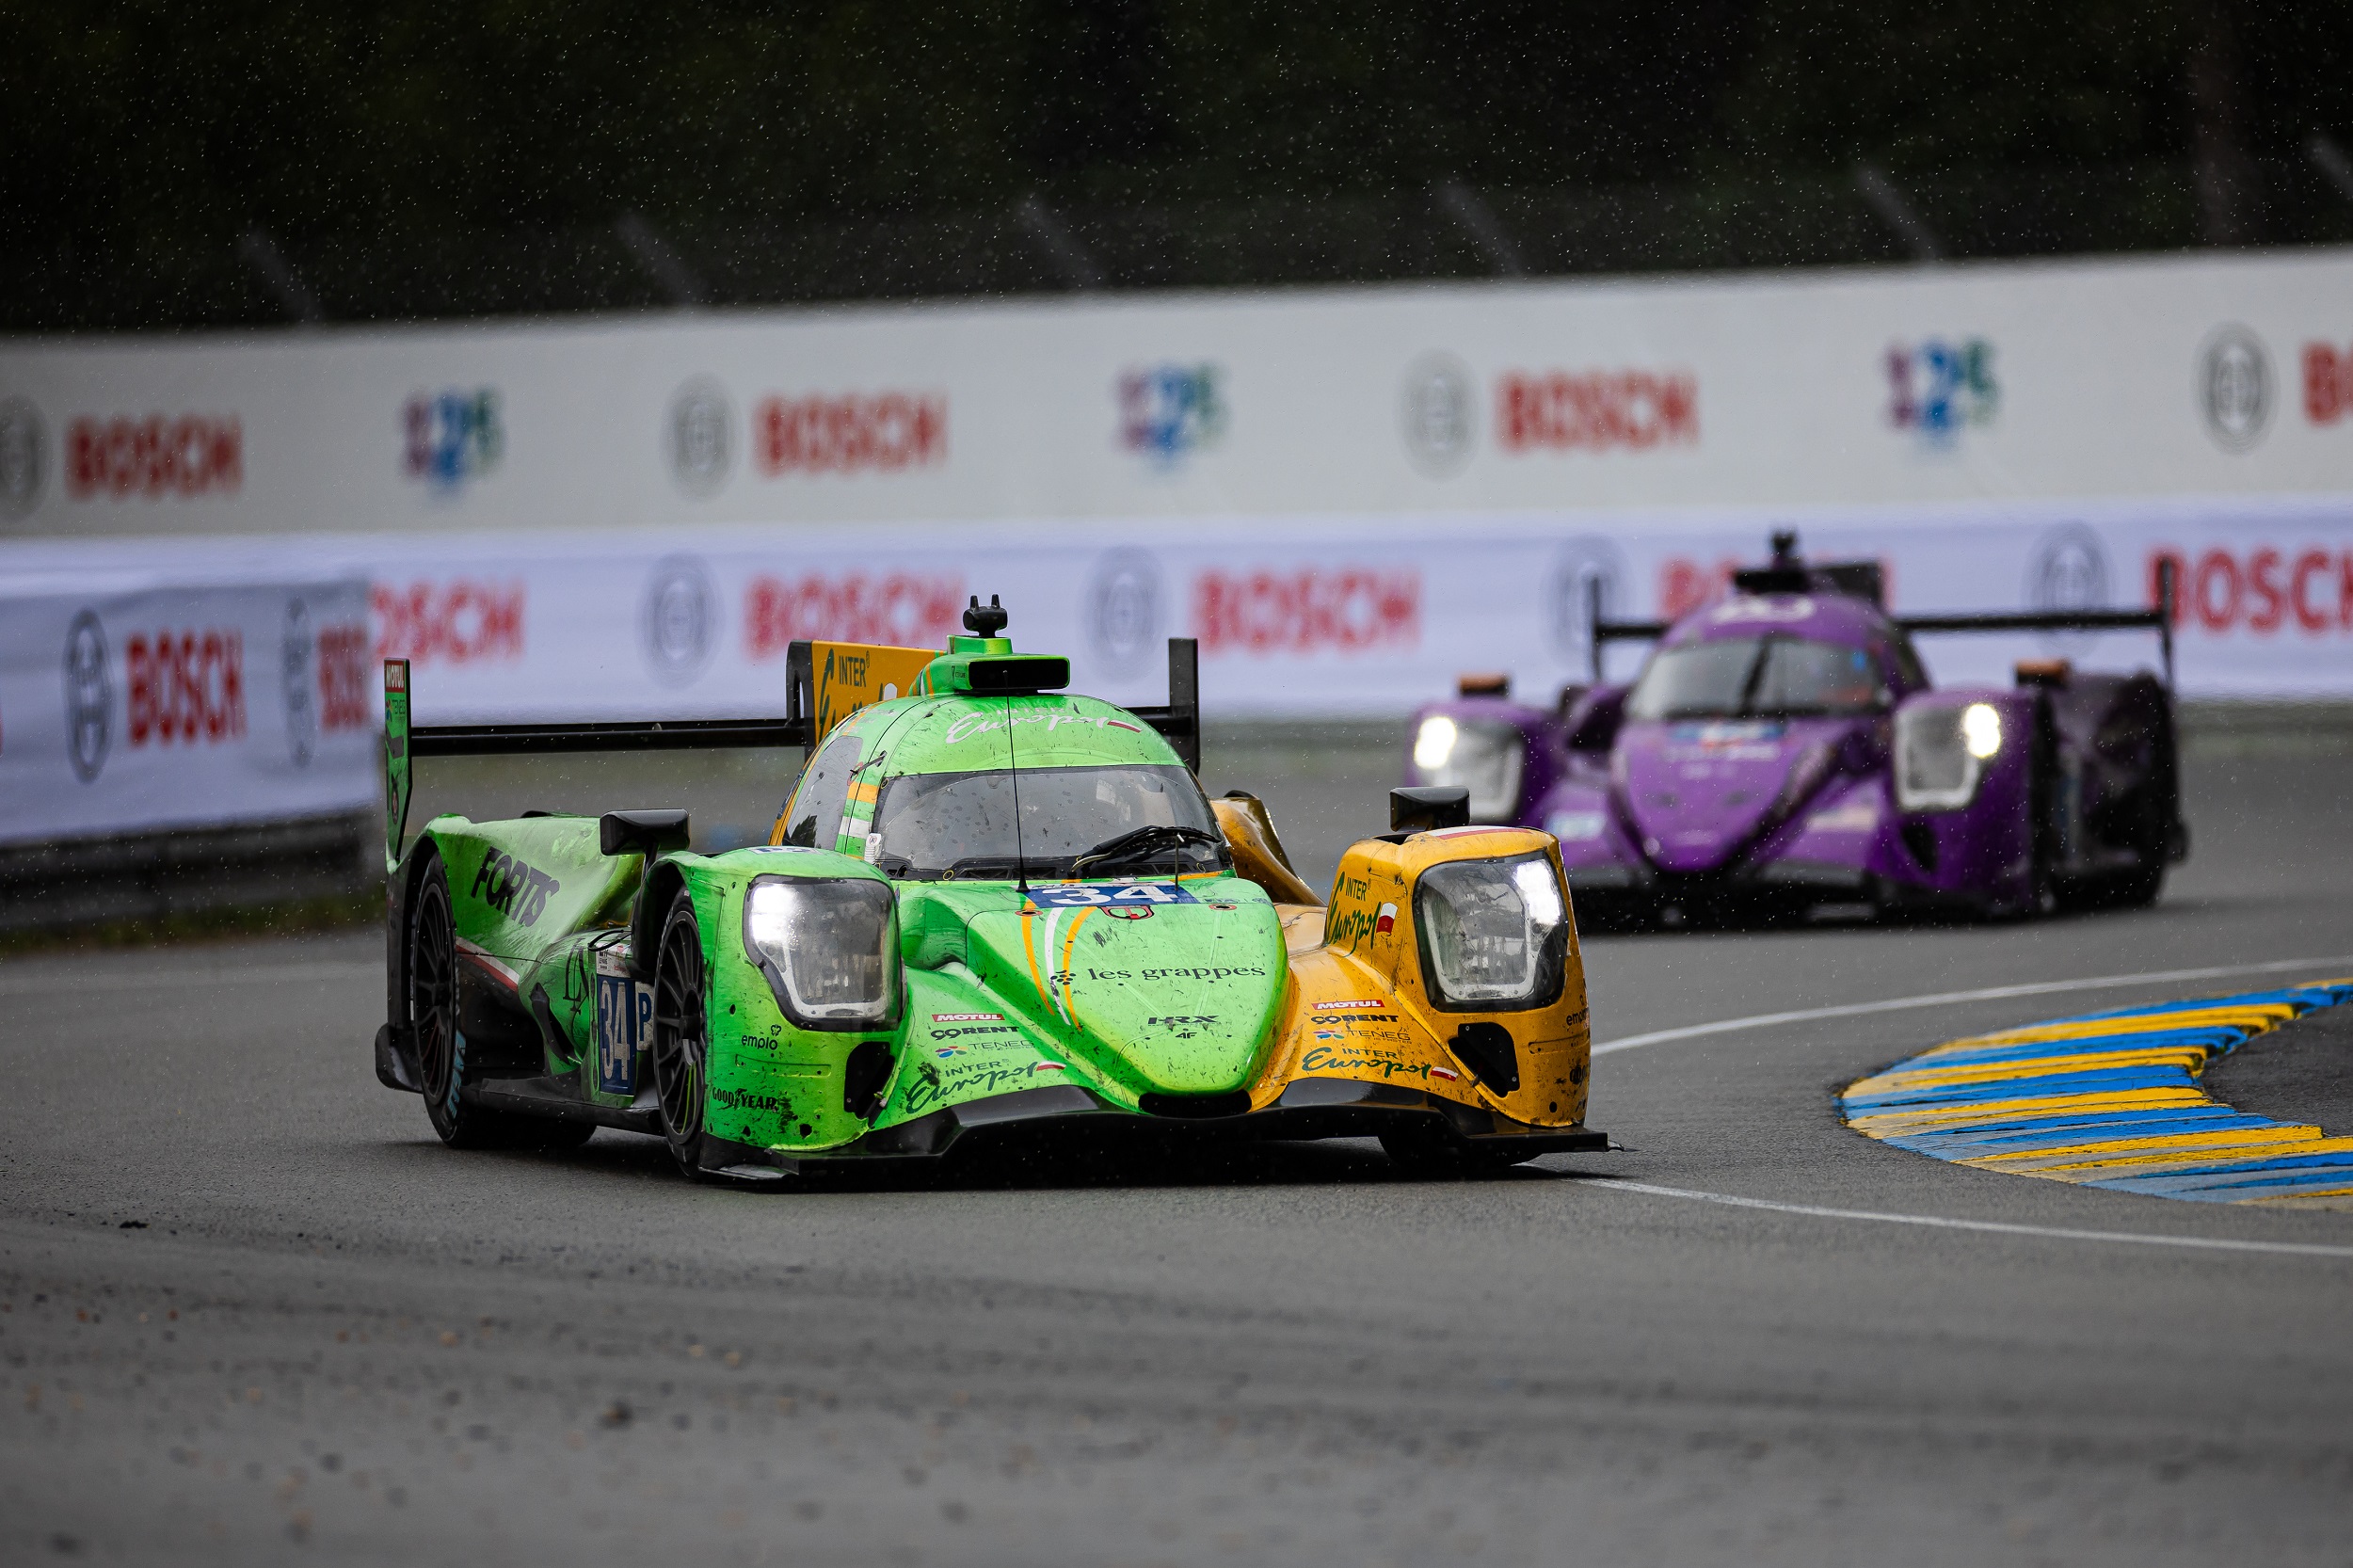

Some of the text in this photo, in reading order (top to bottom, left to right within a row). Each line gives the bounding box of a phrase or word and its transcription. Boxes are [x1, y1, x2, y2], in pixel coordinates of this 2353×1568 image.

[1497, 371, 1699, 453] BOSCH
[753, 392, 947, 477] BOSCH
[66, 415, 243, 499] BOSCH
[1191, 568, 1421, 656] BOSCH
[125, 630, 246, 748] BOSCH
[386, 664, 405, 689] MOTUL
[471, 845, 561, 928] FORTIS
[1042, 886, 1177, 905] 34
[1088, 966, 1266, 981] les grappes
[1310, 1015, 1399, 1025] 99RENT
[1317, 1000, 1382, 1010] MOTUL
[600, 980, 631, 1080] 34
[741, 1034, 778, 1050] emplo
[930, 1026, 1019, 1041] 99RENT
[1301, 1047, 1433, 1080] Europol
[712, 1087, 778, 1112] GOODYEAR
[905, 1061, 1038, 1114] Europol
